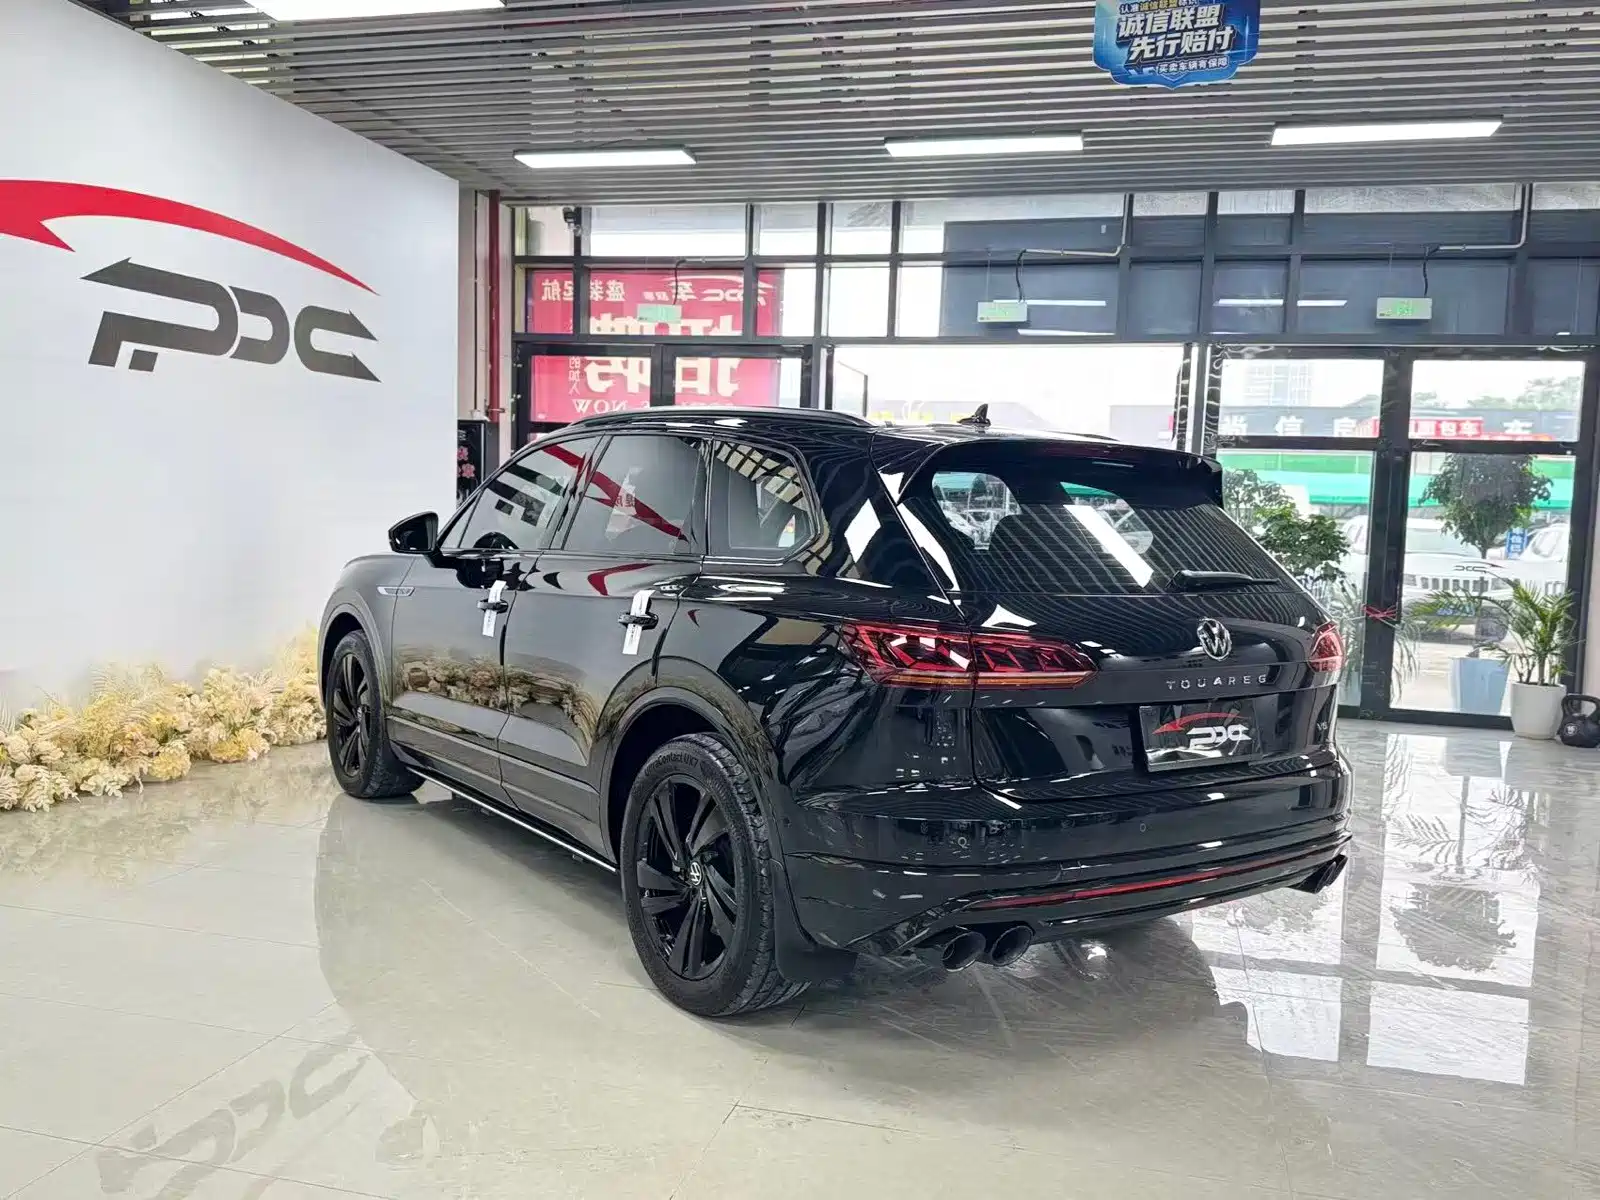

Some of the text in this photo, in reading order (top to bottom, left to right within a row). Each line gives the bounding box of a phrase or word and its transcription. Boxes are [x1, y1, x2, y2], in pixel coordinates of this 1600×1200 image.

[1118, 5, 1221, 38] 诚信联盟
[1131, 26, 1234, 61] 先行赔付
[1159, 57, 1229, 74] 买卖车辆有保障
[1166, 674, 1268, 690] TOUAREG
